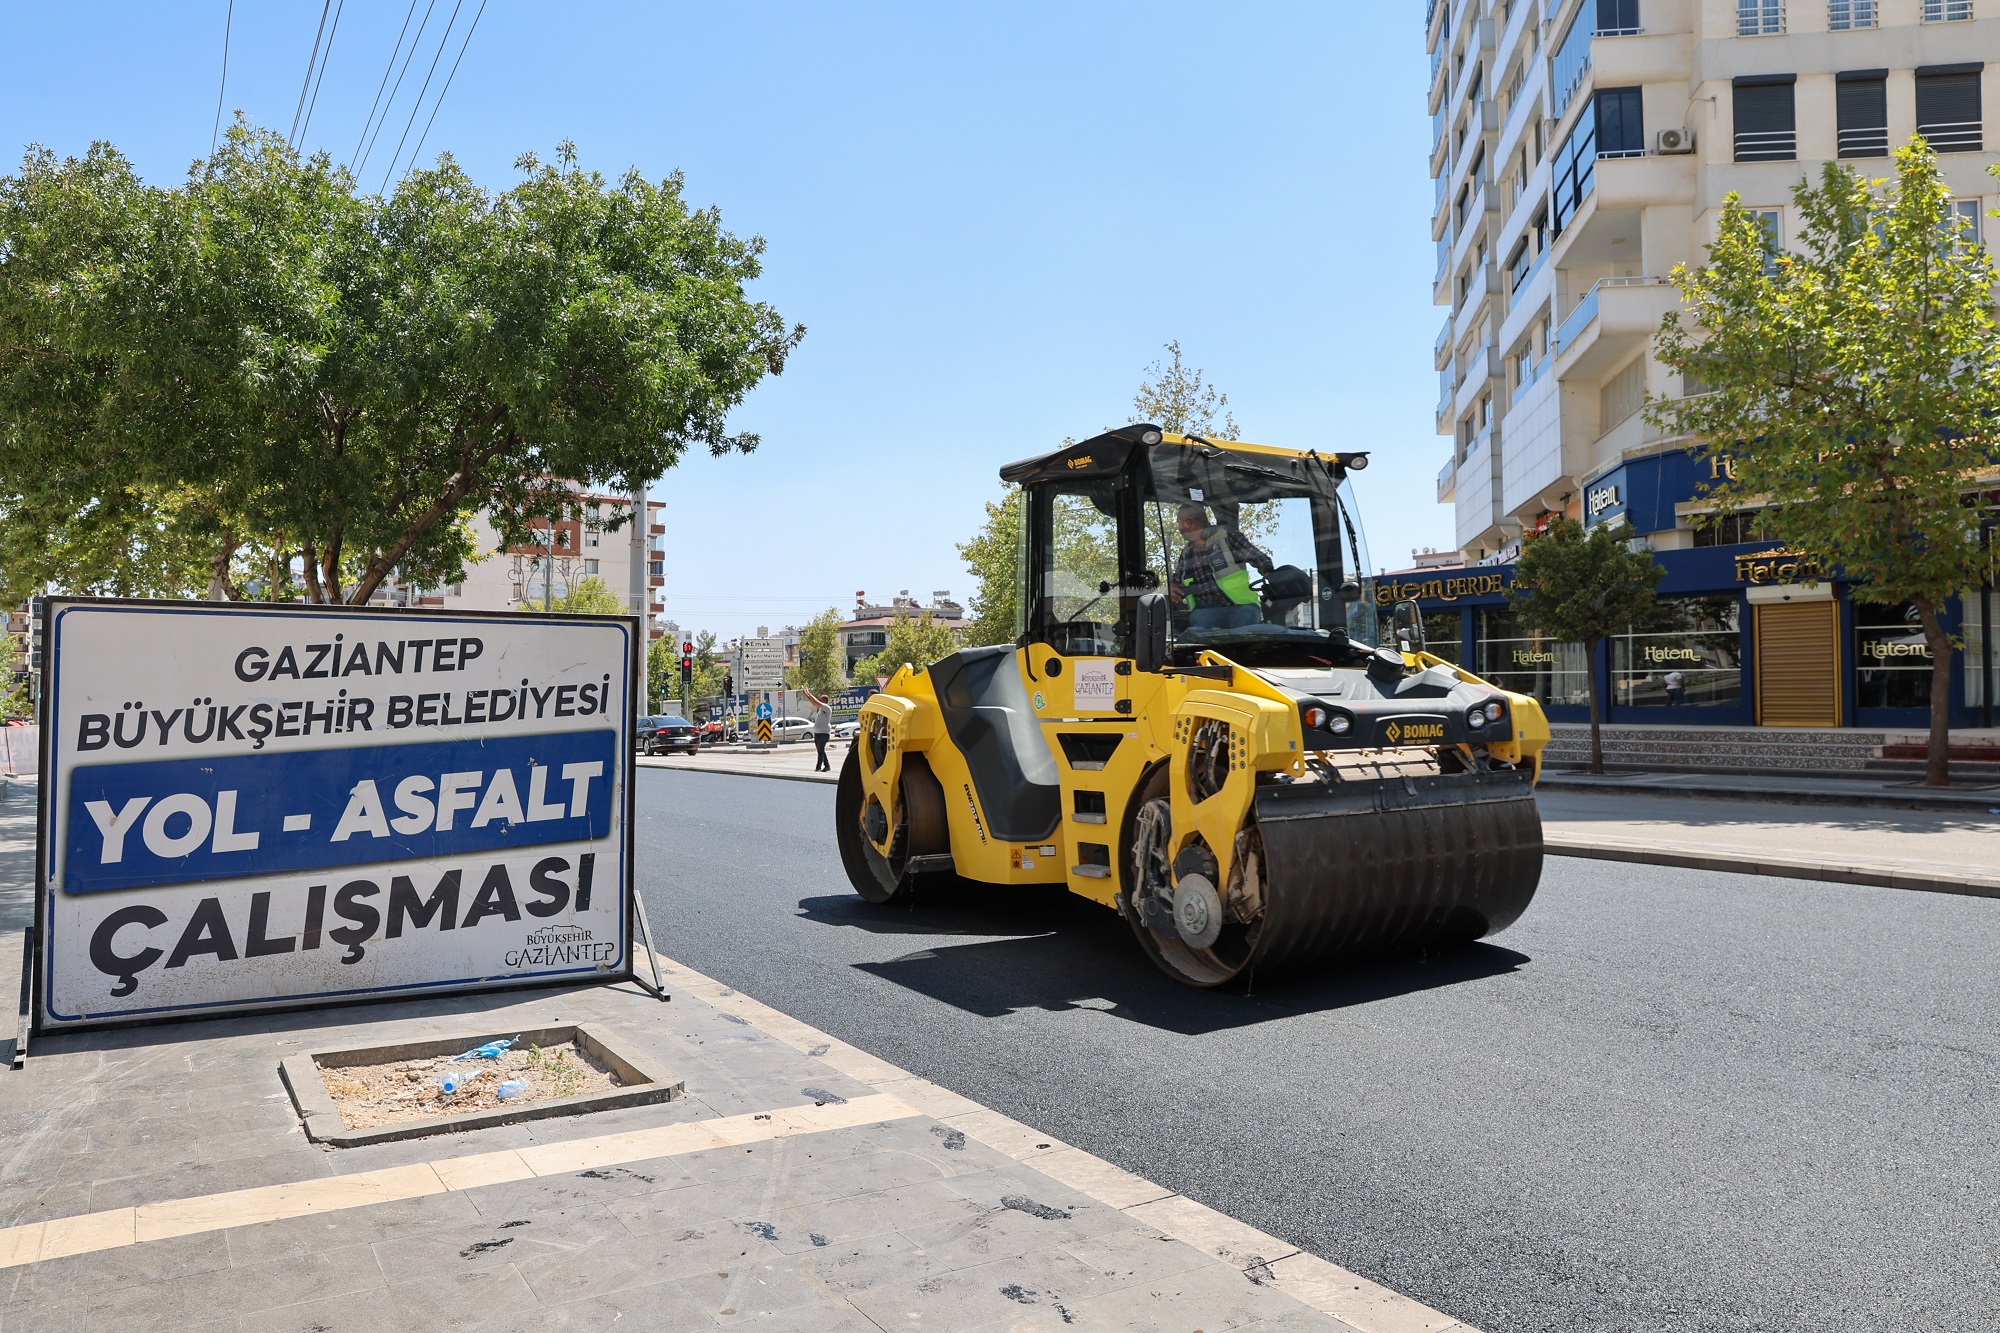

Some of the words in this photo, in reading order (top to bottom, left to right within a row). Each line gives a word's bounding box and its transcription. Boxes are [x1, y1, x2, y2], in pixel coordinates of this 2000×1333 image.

[1588, 486, 1619, 516] Hatem
[1361, 579, 1457, 607] Hatem
[1446, 574, 1502, 596] PERDE
[234, 633, 484, 683] GAZİANTEP
[1513, 650, 1560, 664] Hatem
[1645, 646, 1701, 663] Hatem
[1862, 640, 1934, 659] Hatem
[1075, 682, 1114, 695] GAZİANTEP
[828, 696, 864, 705] EPREM
[77, 688, 375, 751] BÜYÜKŞEHİR
[386, 673, 610, 730] BELEDİYESİ
[711, 706, 722, 716] 15
[726, 705, 748, 715] ADE
[1404, 724, 1443, 738] BOMAG
[85, 790, 259, 864] YOL
[282, 813, 311, 832] -
[330, 760, 604, 842] ASFALT
[89, 853, 596, 996] ÇALIŞMASI
[526, 930, 594, 946] BÜYÜKŞEHİR
[505, 942, 615, 968] GAZİANTEP
